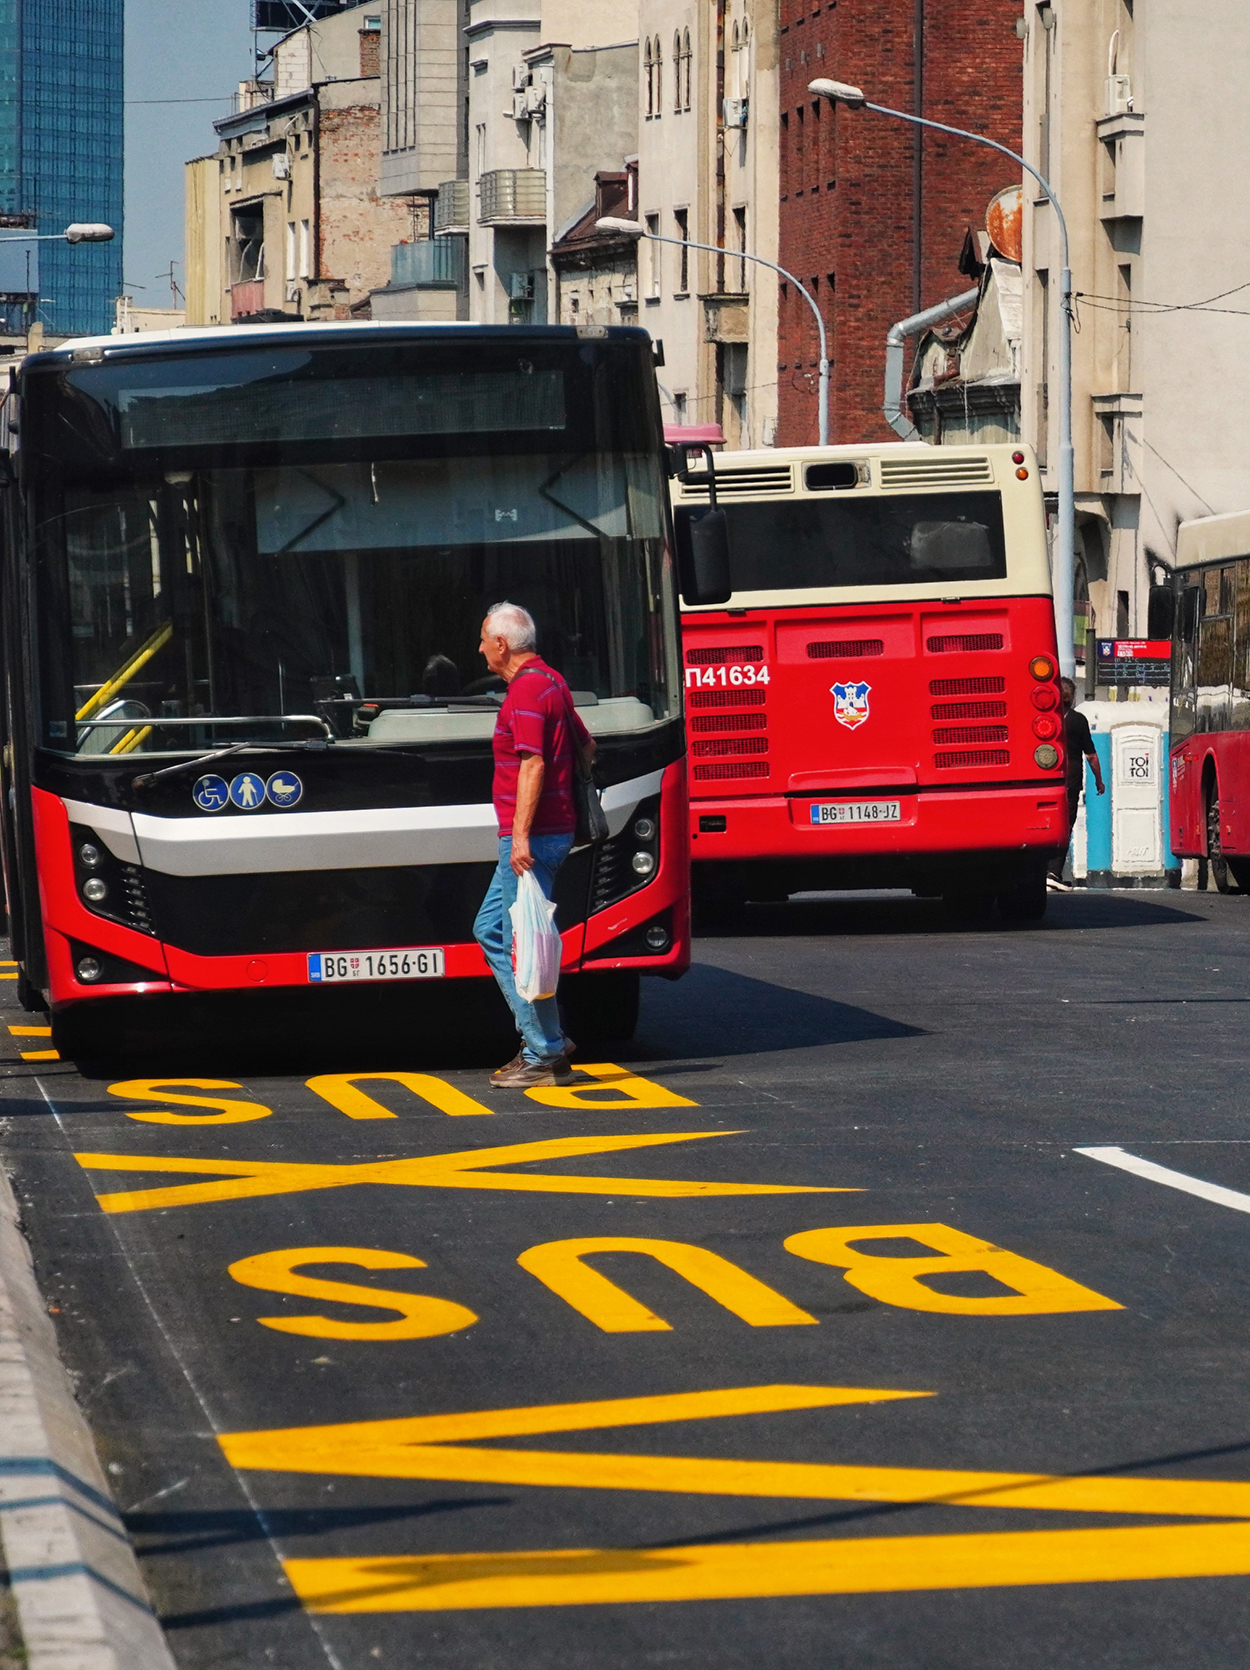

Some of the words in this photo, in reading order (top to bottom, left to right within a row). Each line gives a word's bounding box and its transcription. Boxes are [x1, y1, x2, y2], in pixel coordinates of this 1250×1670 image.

[685, 665, 770, 687] П41634
[821, 806, 837, 821] BG
[324, 957, 348, 978] BG
[227, 1222, 1126, 1341] BUS
